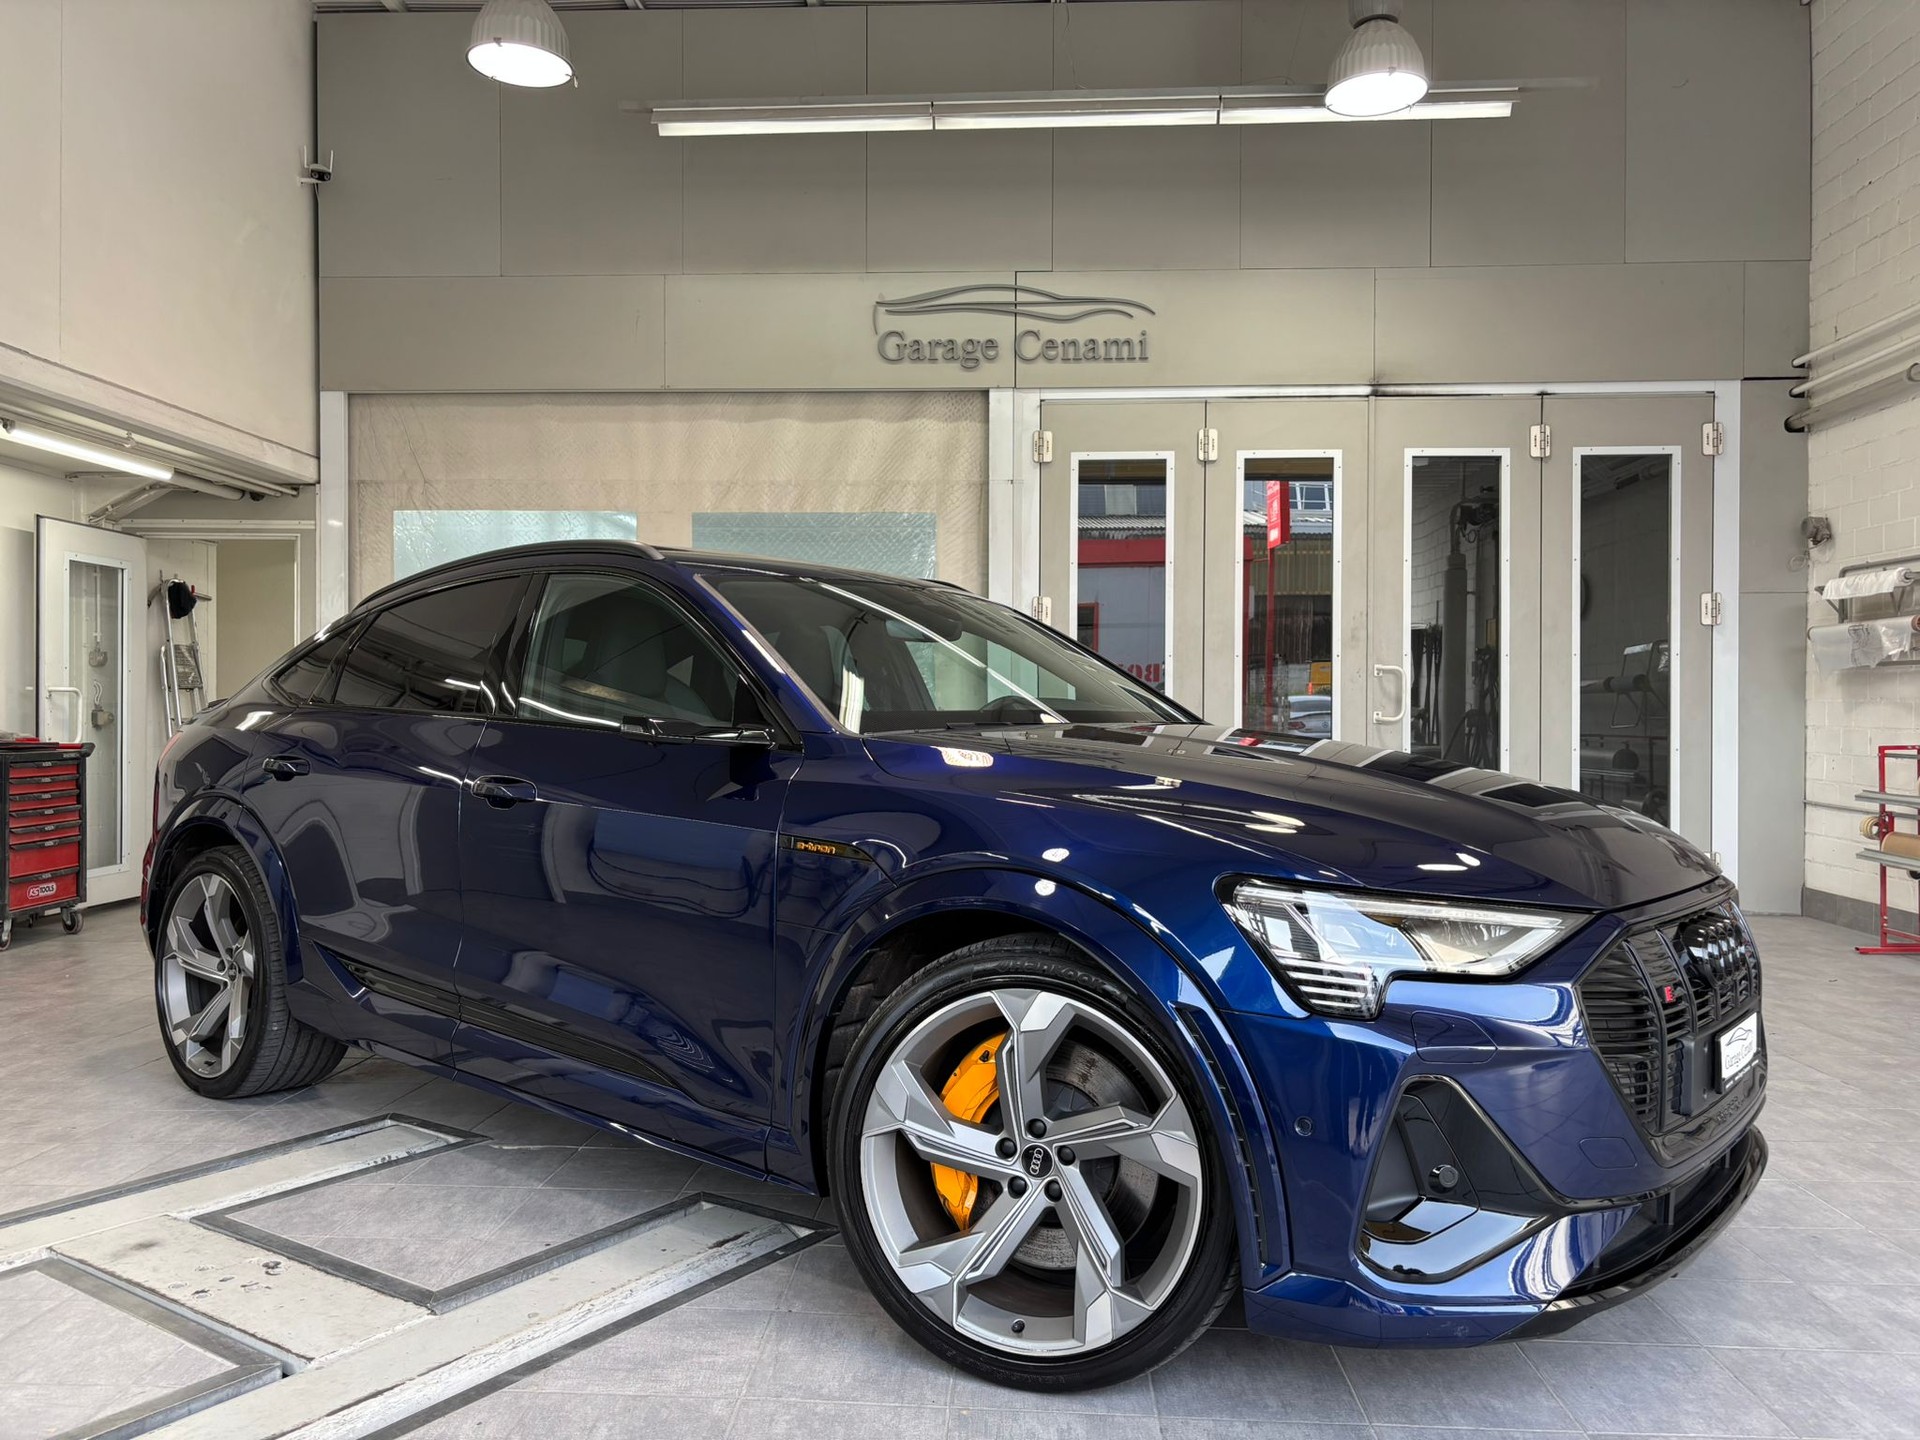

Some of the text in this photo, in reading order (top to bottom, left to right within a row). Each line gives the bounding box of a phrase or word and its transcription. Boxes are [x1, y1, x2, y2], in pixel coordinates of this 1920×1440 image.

[877, 329, 1150, 370] Garage Cenami
[40, 884, 55, 894] TOOLS
